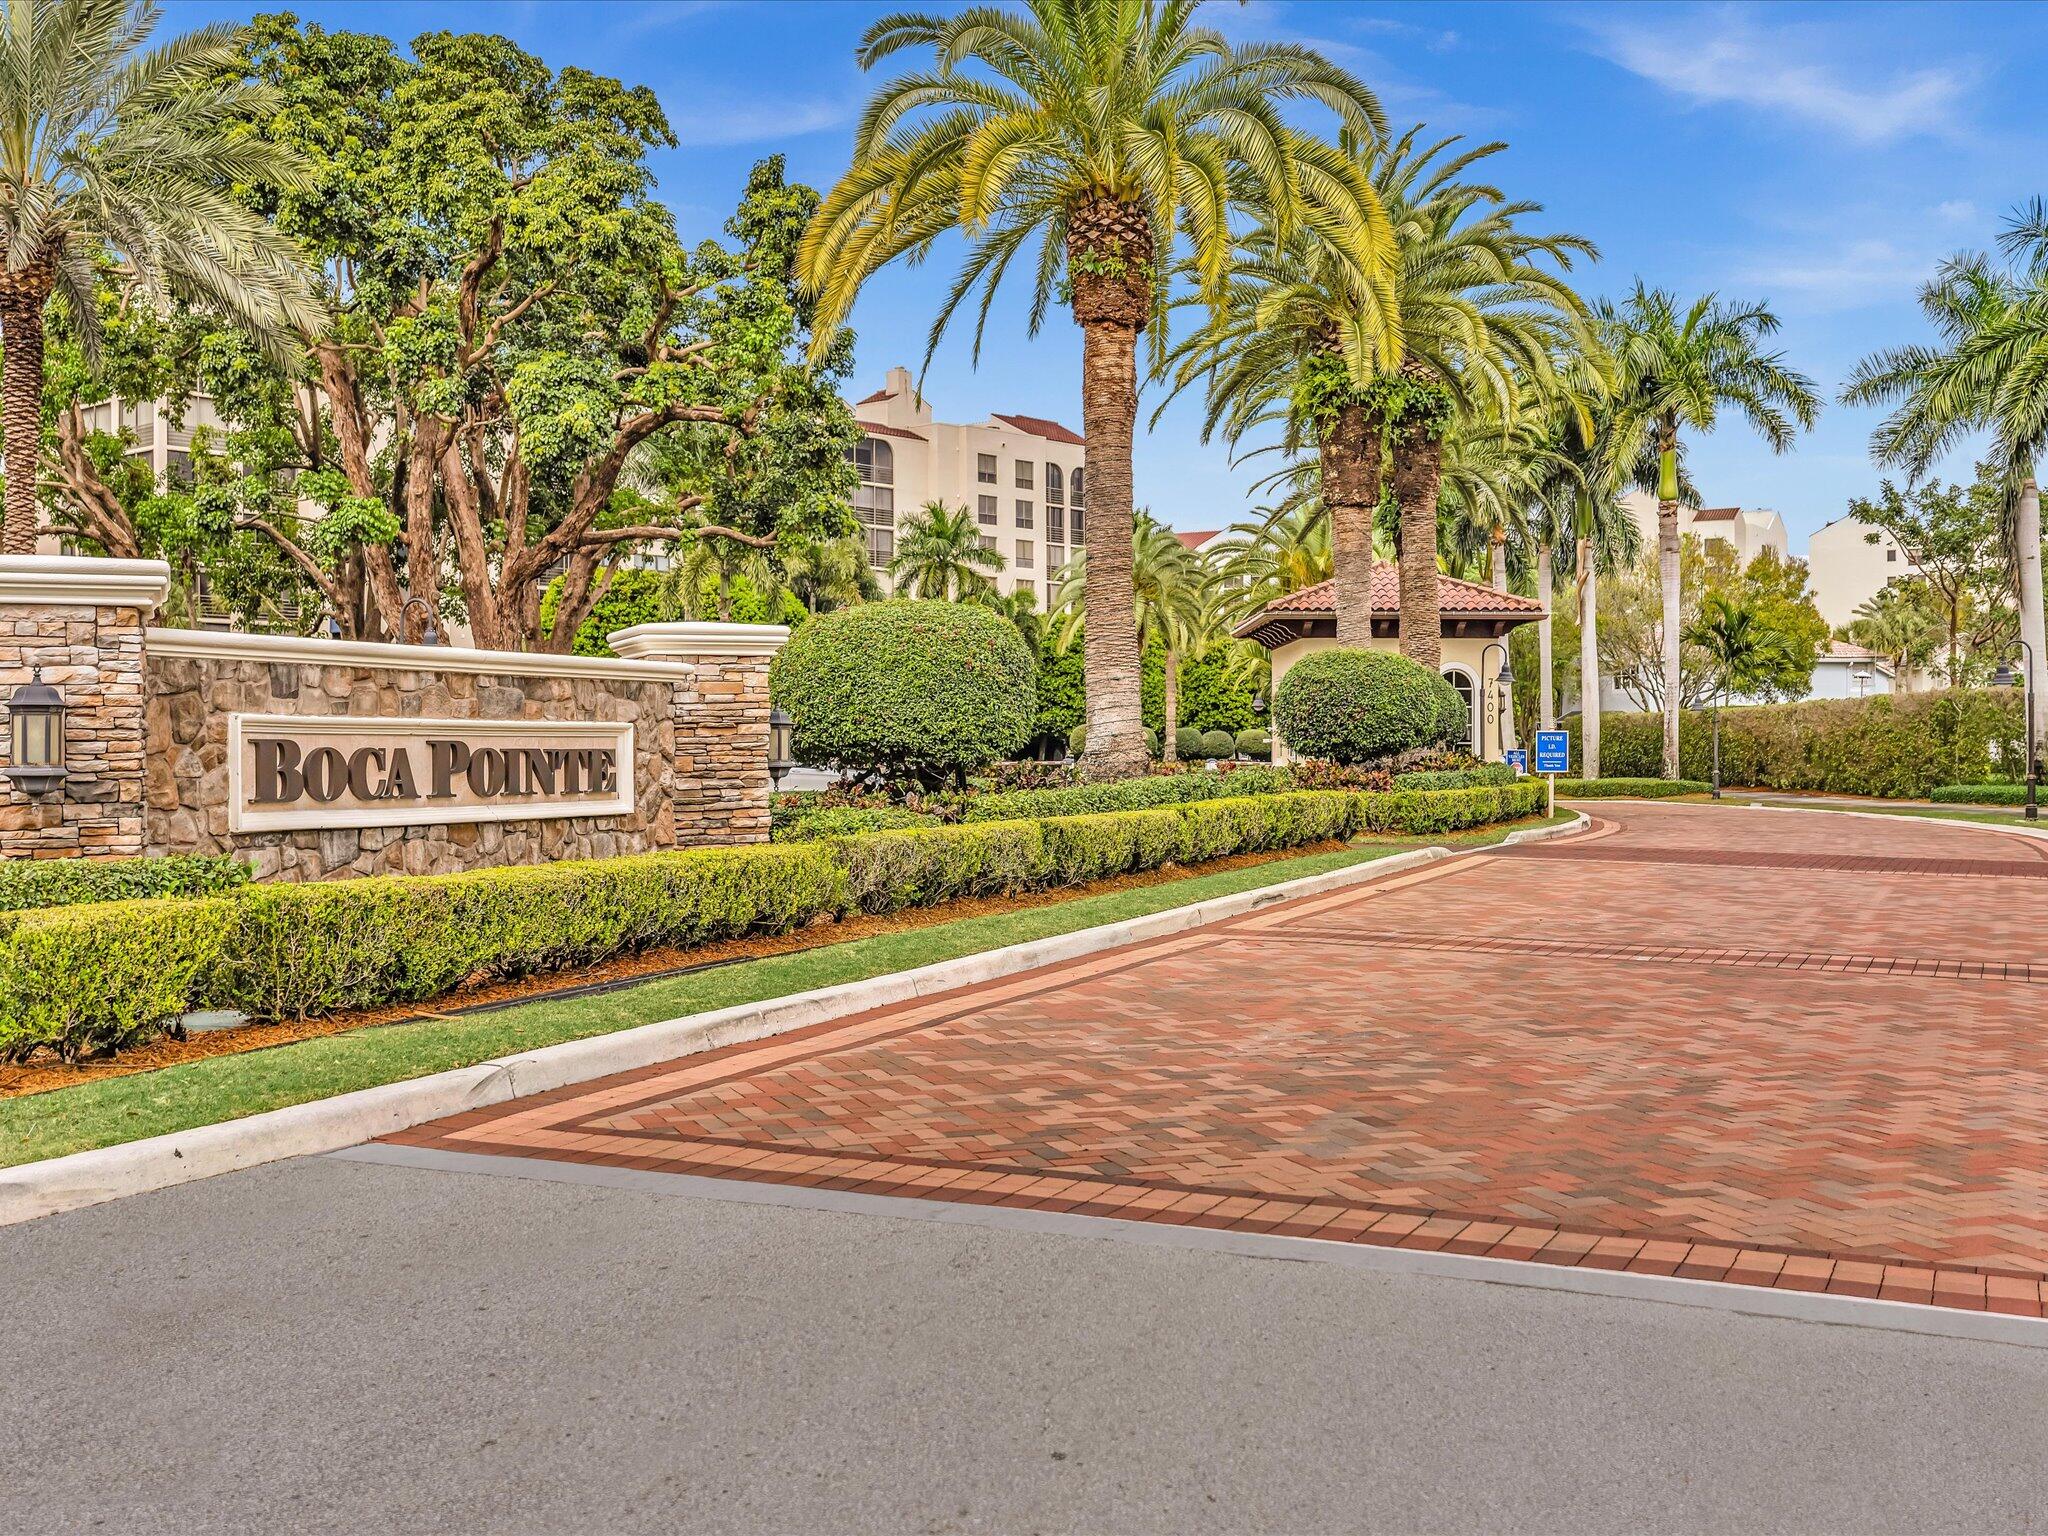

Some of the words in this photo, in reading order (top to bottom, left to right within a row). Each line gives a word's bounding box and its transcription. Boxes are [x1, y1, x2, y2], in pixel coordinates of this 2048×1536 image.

[1487, 678, 1495, 725] 7400
[248, 738, 421, 803] BOCA
[426, 740, 617, 799] POINTE
